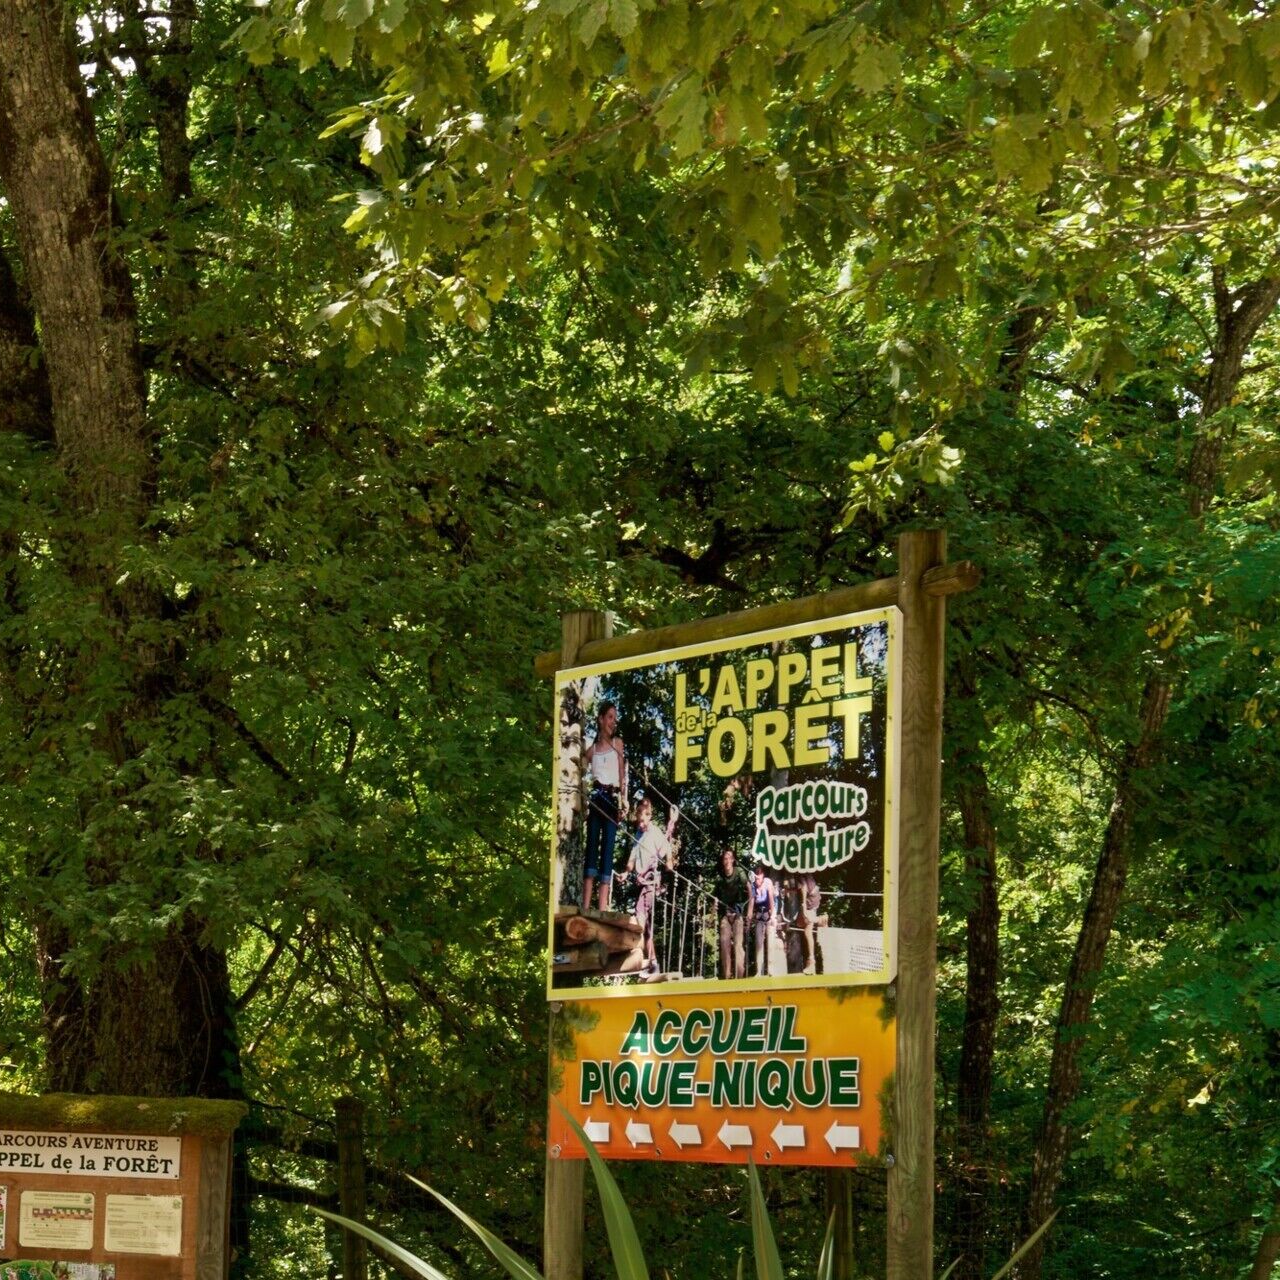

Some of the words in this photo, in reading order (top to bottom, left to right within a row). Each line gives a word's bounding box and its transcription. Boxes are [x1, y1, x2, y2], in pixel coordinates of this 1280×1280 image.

[675, 643, 873, 718] L'APPEL
[674, 688, 873, 784] FORÊT
[675, 711, 697, 733] de
[700, 709, 718, 729] la
[759, 784, 865, 824] Parcours
[755, 825, 867, 869] Aventure
[619, 1005, 807, 1056] ACCUEIL
[579, 1057, 860, 1111] PIQUE-NIQUE
[51, 1153, 73, 1169] de
[80, 1155, 96, 1171] la
[104, 1154, 173, 1174] FORÊT
[73, 1137, 159, 1152] AVENTURE
